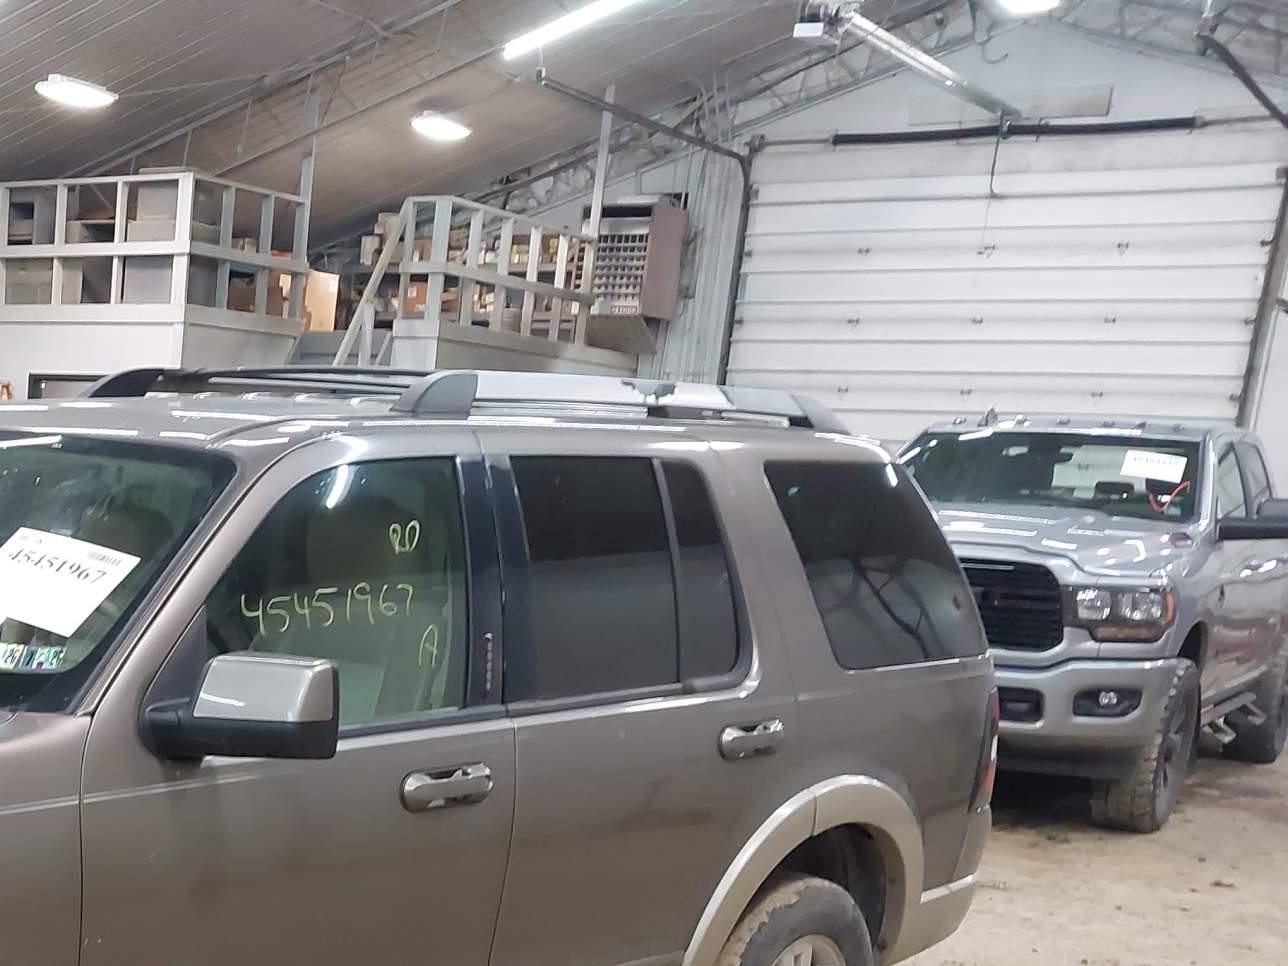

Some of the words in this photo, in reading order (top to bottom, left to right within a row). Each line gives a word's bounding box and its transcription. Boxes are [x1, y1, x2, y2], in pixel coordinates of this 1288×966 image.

[9, 548, 108, 584] 45451967
[240, 582, 414, 636] 45451967
[418, 623, 440, 667] A
